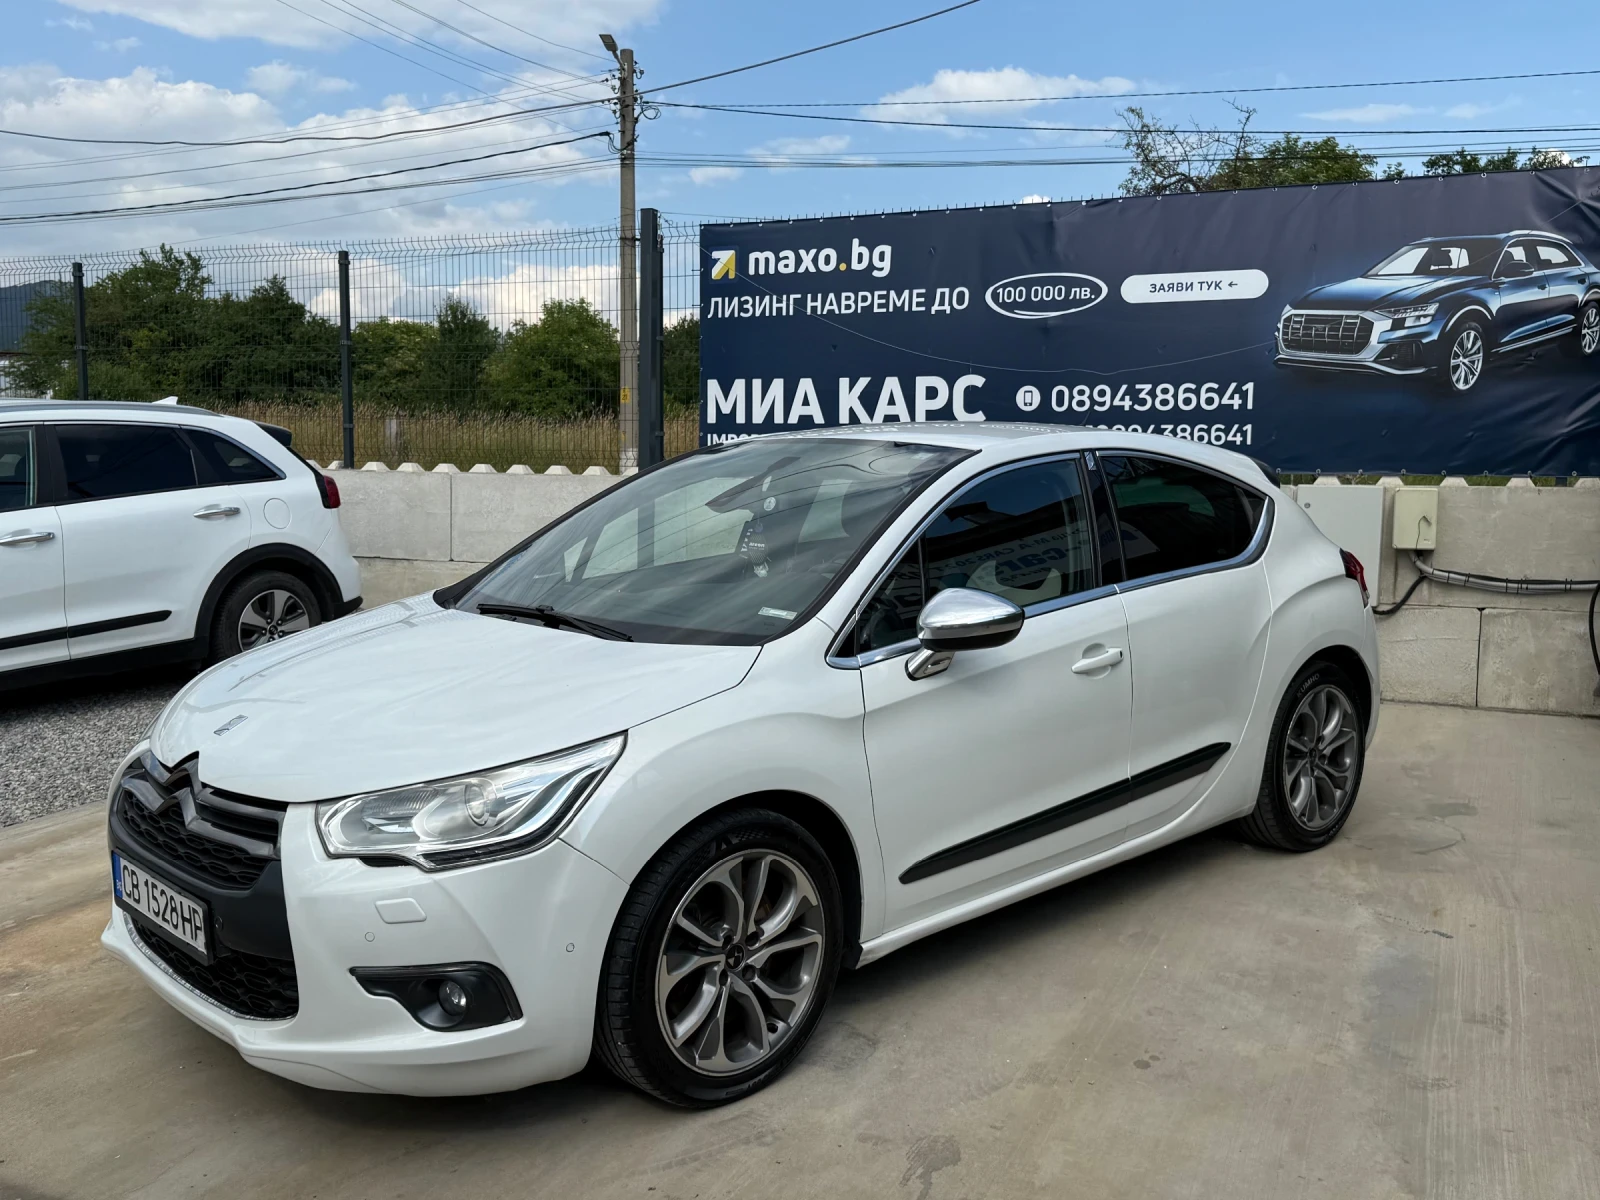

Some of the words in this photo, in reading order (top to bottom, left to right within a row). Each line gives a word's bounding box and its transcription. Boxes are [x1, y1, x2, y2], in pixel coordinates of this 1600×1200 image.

[749, 238, 892, 277] maxo.bg
[708, 293, 802, 318] ЛИЗИНГ
[807, 289, 926, 315] НАВРЕМЕ
[931, 287, 970, 314] ДО
[996, 286, 1026, 303] 100
[1031, 285, 1066, 302] 000
[1149, 281, 1194, 294] ЗАЯВИ
[1198, 280, 1223, 292] ТУК
[706, 377, 825, 424] МИА
[838, 374, 987, 424] КАРС
[1051, 382, 1255, 412] 0894386641
[144, 878, 180, 930] 1528
